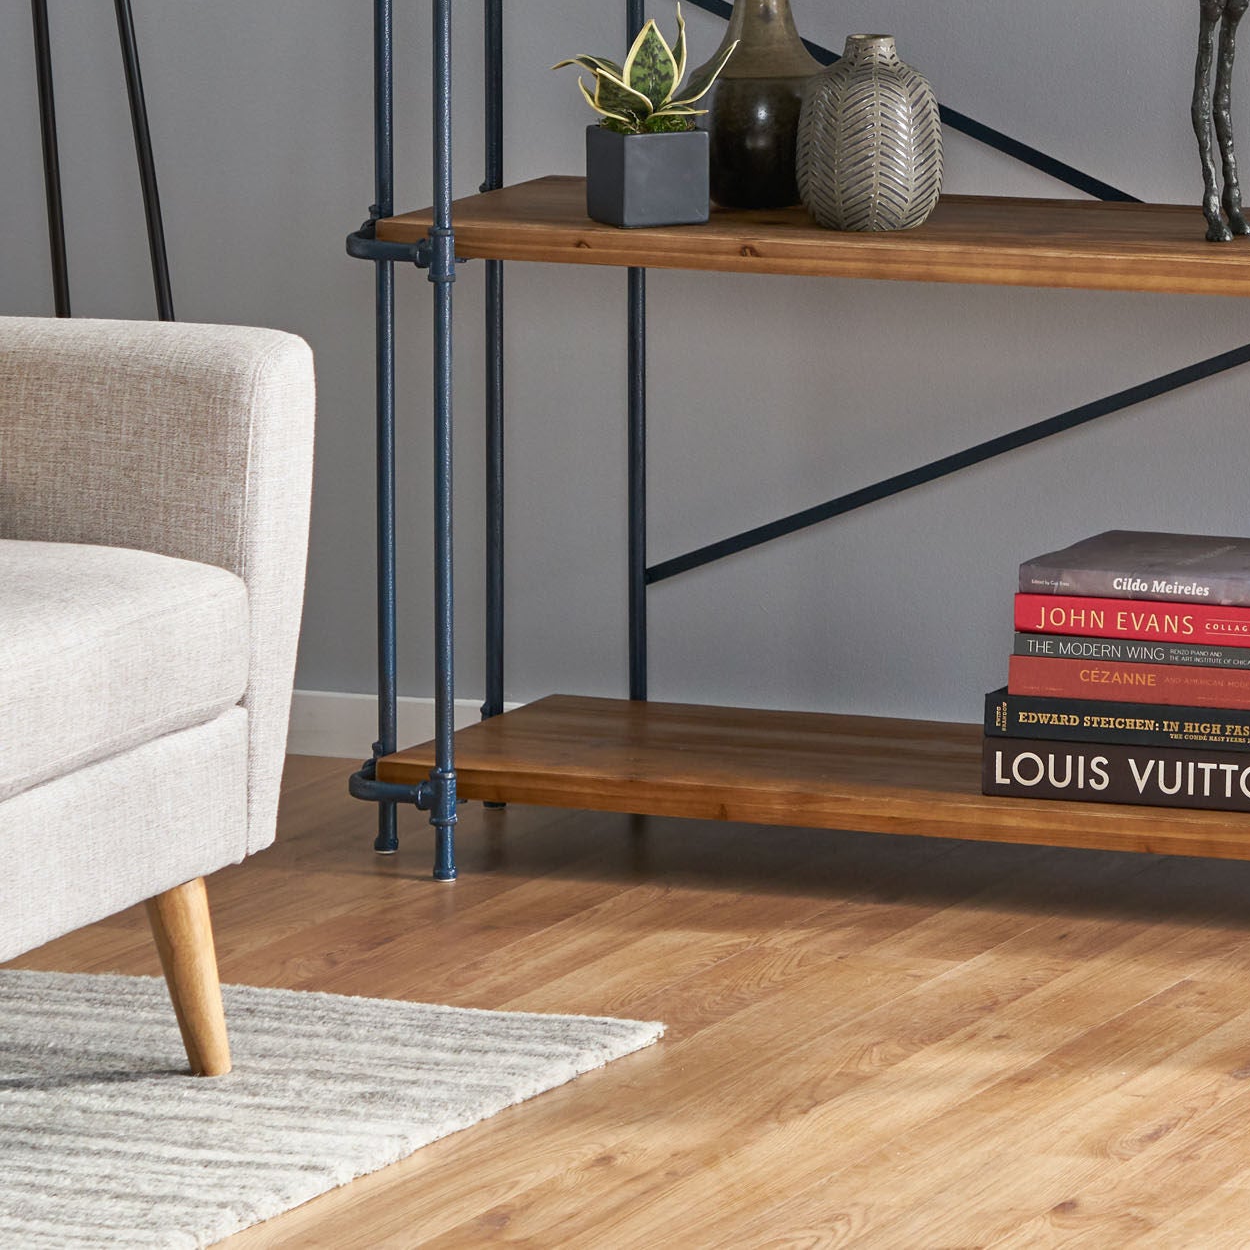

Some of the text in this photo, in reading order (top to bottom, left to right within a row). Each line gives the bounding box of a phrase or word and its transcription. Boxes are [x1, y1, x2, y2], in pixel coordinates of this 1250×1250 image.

[1113, 577, 1210, 597] Cildo Meireles
[1036, 606, 1194, 635] JOHN EVANS
[1027, 640, 1165, 661] THE MODERN WING
[1169, 654, 1180, 662] THE
[1181, 655, 1193, 663] ART
[1193, 656, 1222, 664] INSTITUTE
[1190, 649, 1209, 657] PIANO
[1209, 650, 1223, 658] AND
[1079, 667, 1157, 686] CÉZANNE
[1018, 711, 1080, 727] EDWARD
[1083, 716, 1160, 731] STEICHEN:
[1162, 720, 1179, 733] IN
[1183, 721, 1221, 735] HIGH
[995, 751, 1110, 791] LOUIS
